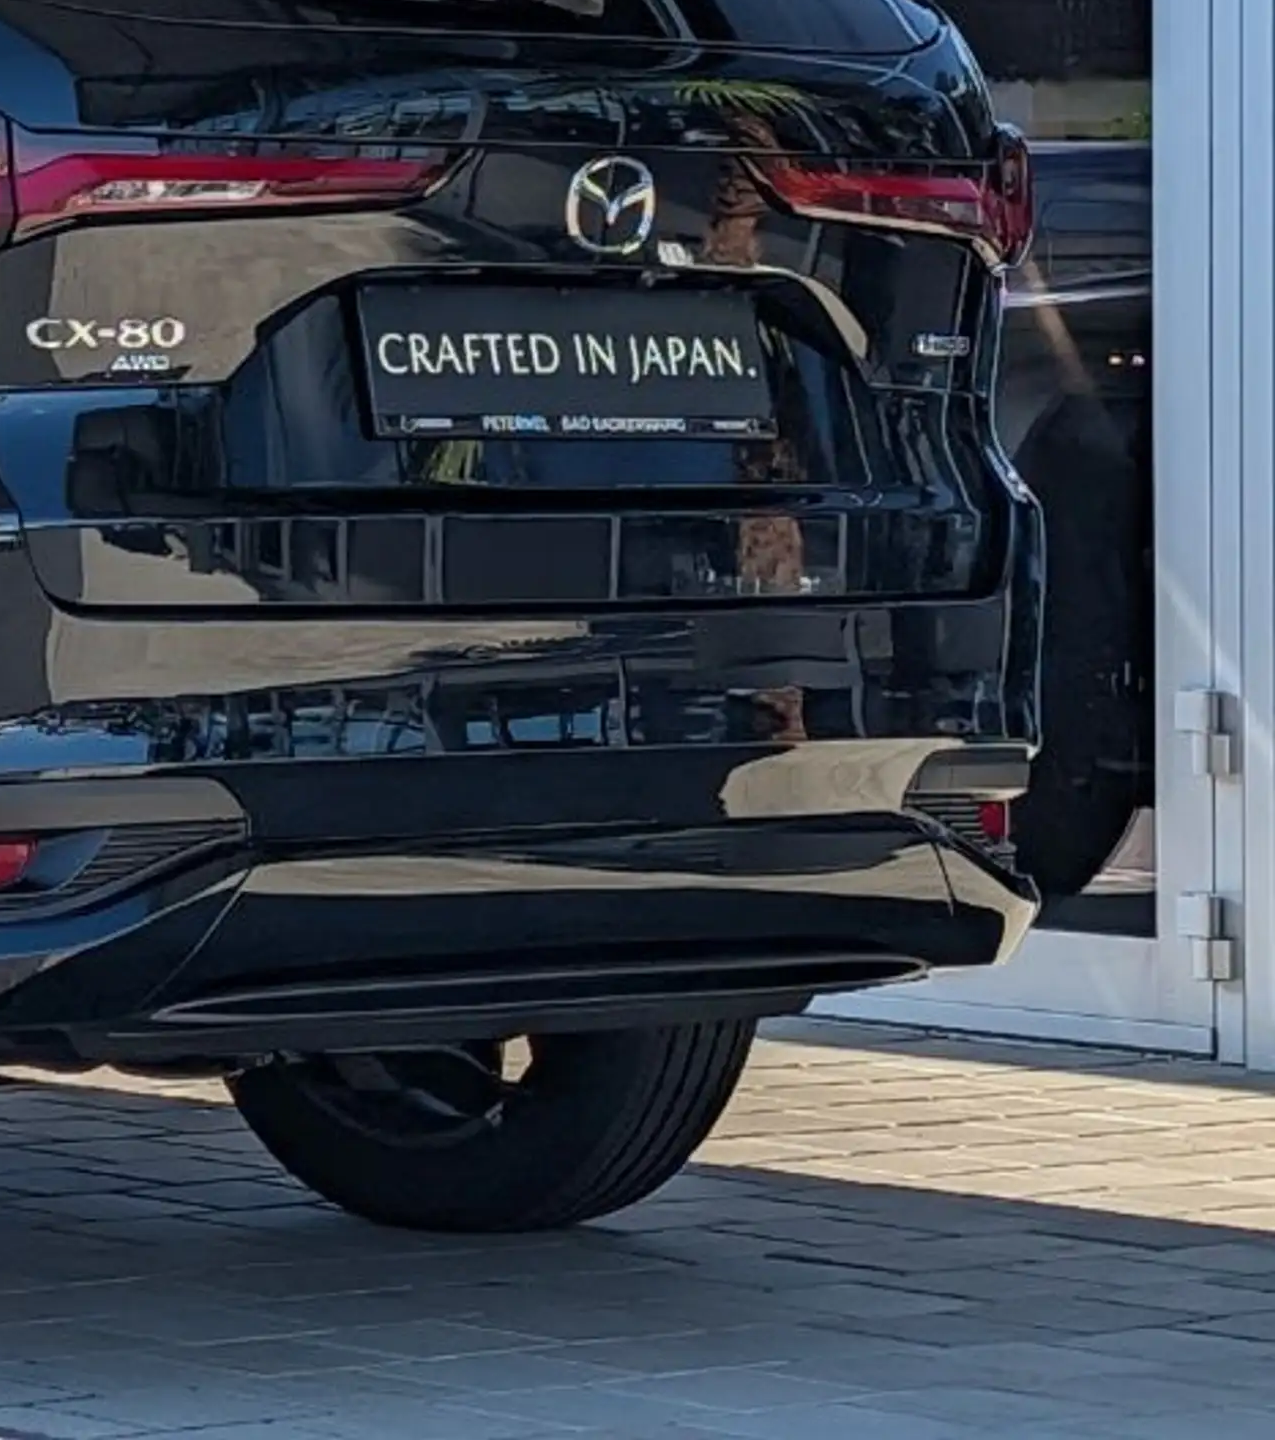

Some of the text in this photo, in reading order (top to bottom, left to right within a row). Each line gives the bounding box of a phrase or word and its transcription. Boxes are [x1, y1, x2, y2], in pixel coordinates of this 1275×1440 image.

[25, 317, 186, 349] CX-80
[110, 354, 171, 371] AWD
[377, 332, 758, 384] CRAFTED IN JAPAN.
